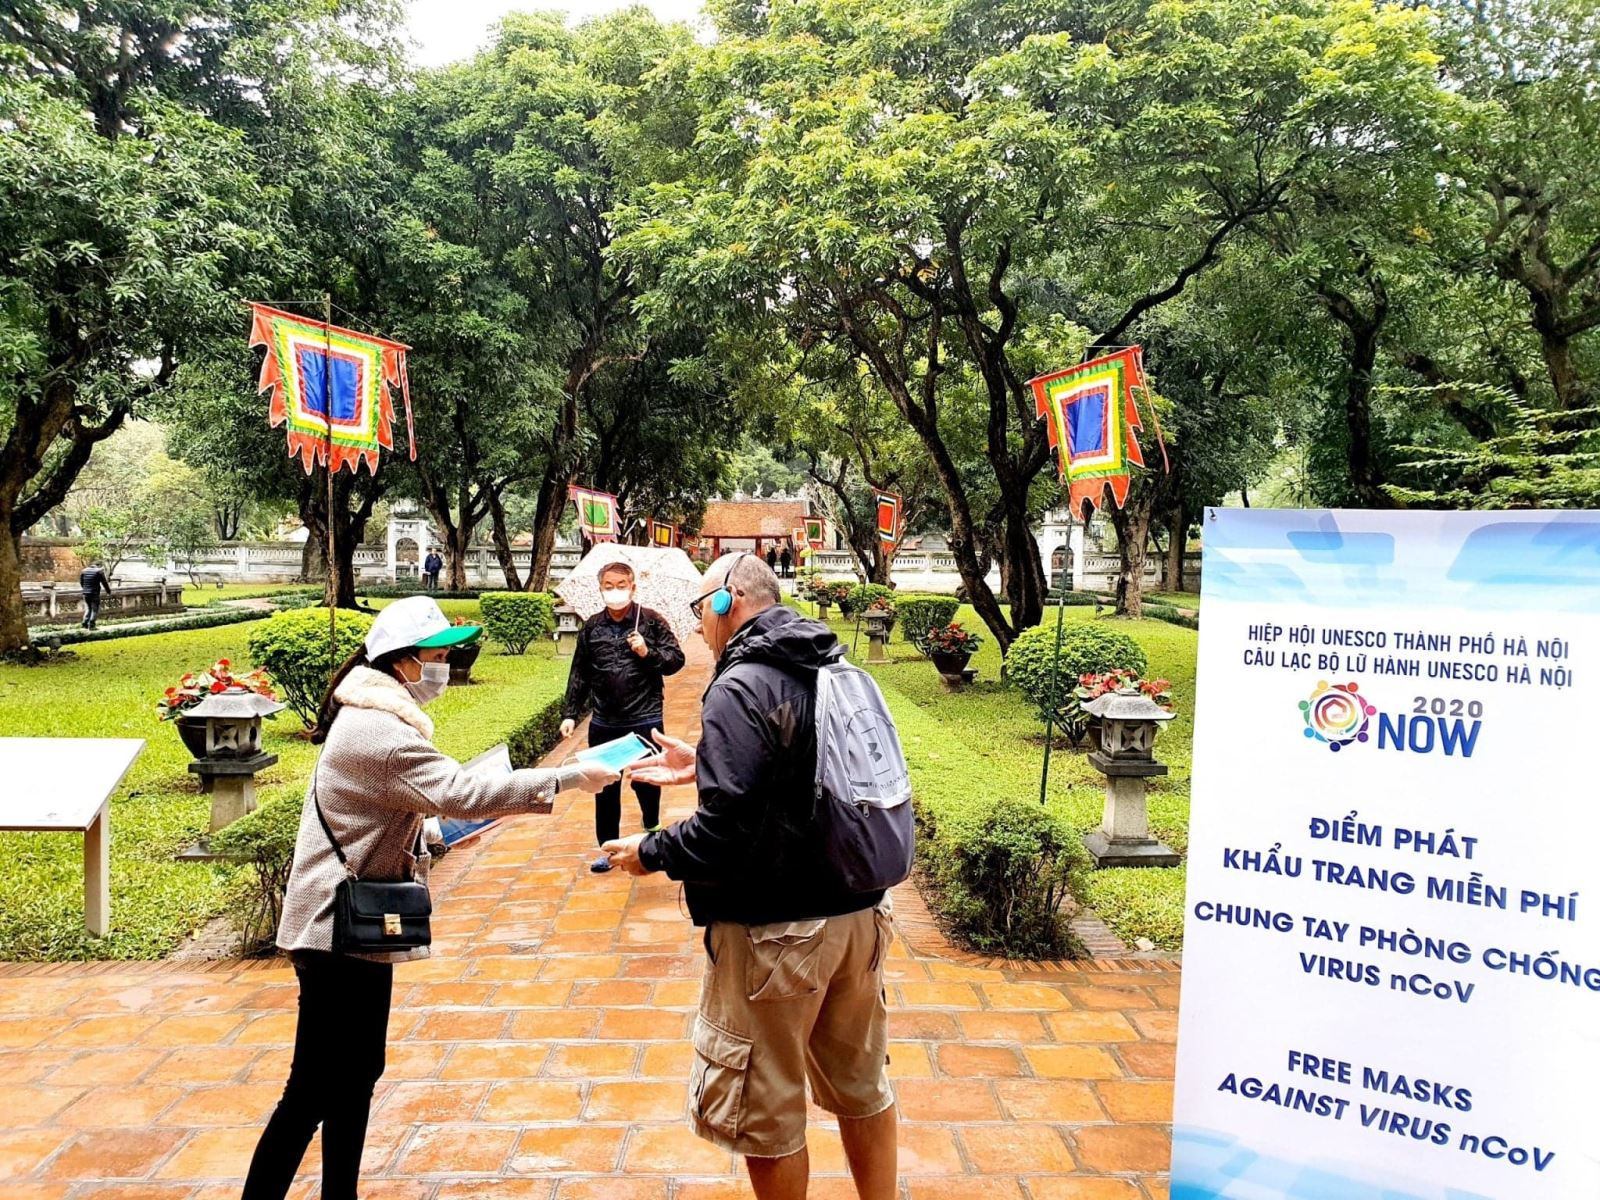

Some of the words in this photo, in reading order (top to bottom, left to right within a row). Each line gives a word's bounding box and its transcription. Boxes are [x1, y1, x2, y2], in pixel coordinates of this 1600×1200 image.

[1249, 623, 1283, 644] HIỆP
[1289, 625, 1315, 646] HỘI
[1322, 629, 1387, 648] UNESCO
[1394, 631, 1451, 652] THÀNH
[1459, 632, 1495, 654] PHỐ
[1504, 636, 1528, 656] HÀ
[1537, 638, 1569, 662] NỘI
[1244, 647, 1275, 667] CÂU
[1282, 651, 1311, 671] LẠC
[1318, 652, 1340, 674] BỘ
[1347, 653, 1367, 673] LỮ
[1374, 655, 1419, 676] HÀNH
[1428, 661, 1499, 682] UNESCO
[1507, 664, 1532, 684] HÀ
[1540, 666, 1572, 690] NỘI
[1412, 697, 1483, 719] 2020
[1378, 712, 1482, 758] NOW
[1309, 810, 1382, 847] ĐIỂM
[1394, 828, 1478, 860] PHÁT
[1224, 842, 1302, 877] KHẨU
[1312, 860, 1415, 895] TRANG
[1427, 872, 1507, 909] MIỄN
[1520, 889, 1579, 921] PHÍ
[1194, 901, 1294, 933] CHUNG
[1303, 916, 1350, 942] TAY
[1359, 926, 1472, 964] PHÒNG
[1482, 948, 1600, 992] CHỐNG
[1299, 952, 1380, 986] VIRUS
[1390, 973, 1476, 1003] nCoV
[1288, 1050, 1352, 1085] FREE
[1362, 1067, 1473, 1112] MASKS
[1217, 1072, 1350, 1121] AGAINST
[1359, 1104, 1452, 1146] VIRUS
[1459, 1133, 1556, 1172] nCoV
